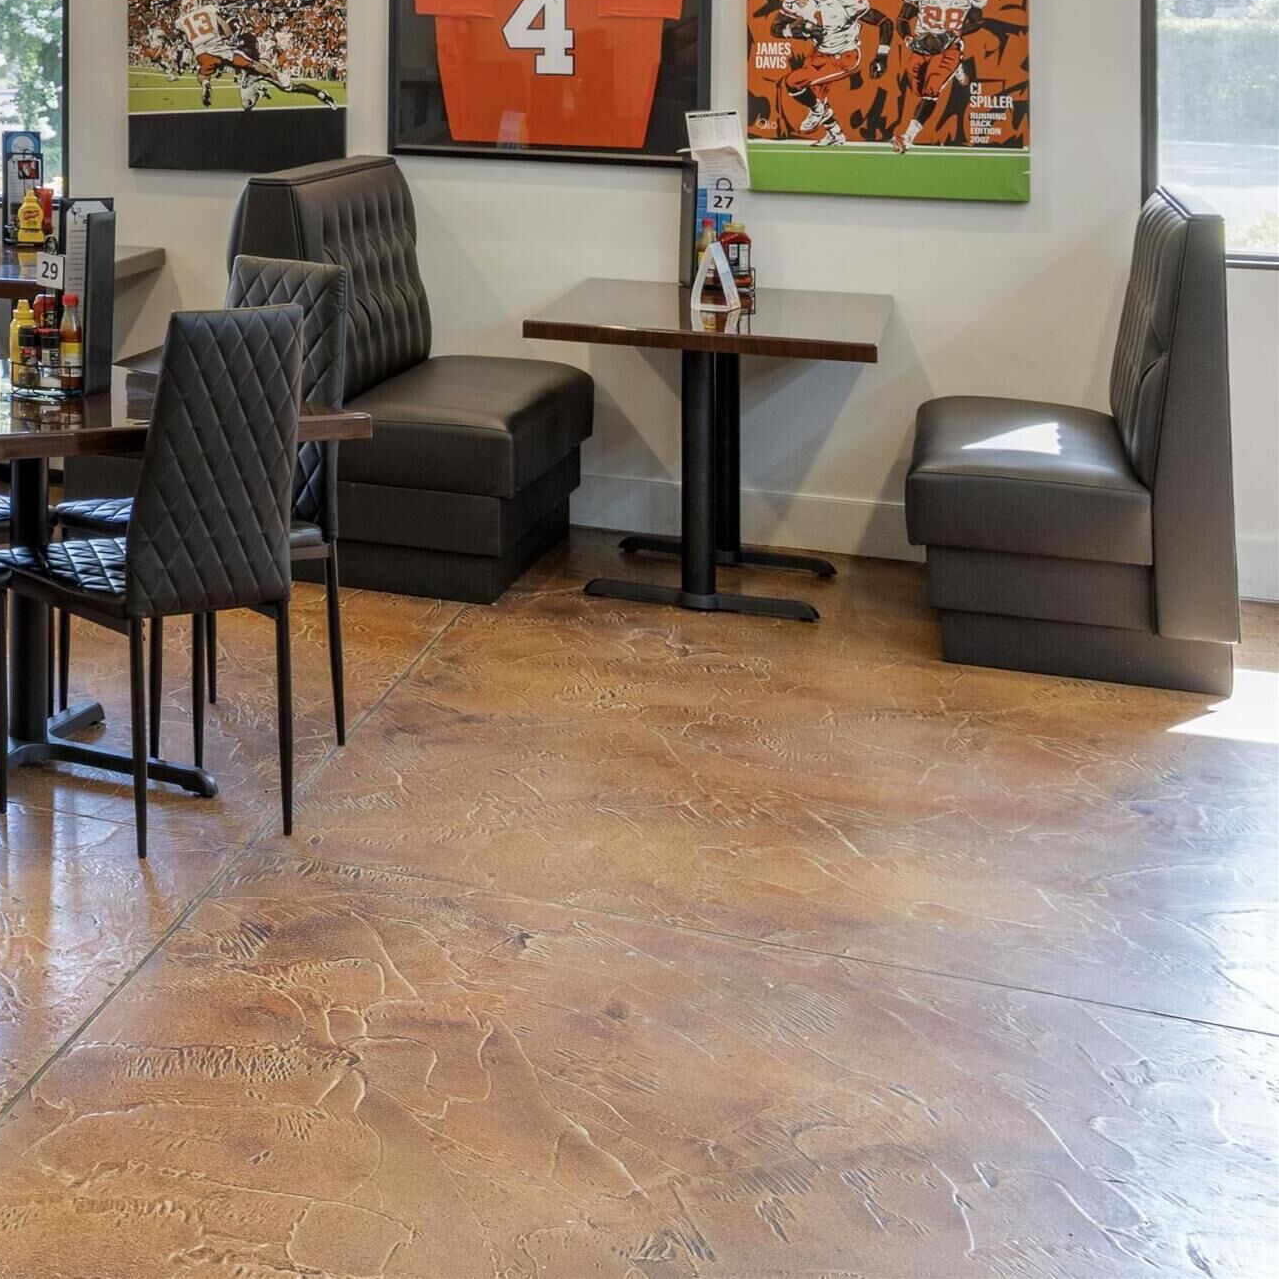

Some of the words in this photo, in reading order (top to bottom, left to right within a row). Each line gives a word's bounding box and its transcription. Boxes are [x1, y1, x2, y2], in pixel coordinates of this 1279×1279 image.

[183, 10, 215, 40] 13
[755, 42, 792, 56] JAMES
[755, 56, 787, 69] DAVIS
[970, 82, 982, 95] CJ
[970, 95, 1014, 109] SPILLER
[970, 112, 1007, 121] RUNNING
[970, 127, 1001, 135] EDITION
[970, 136, 990, 144] 2007
[713, 196, 734, 209] 27
[41, 261, 58, 281] 29
